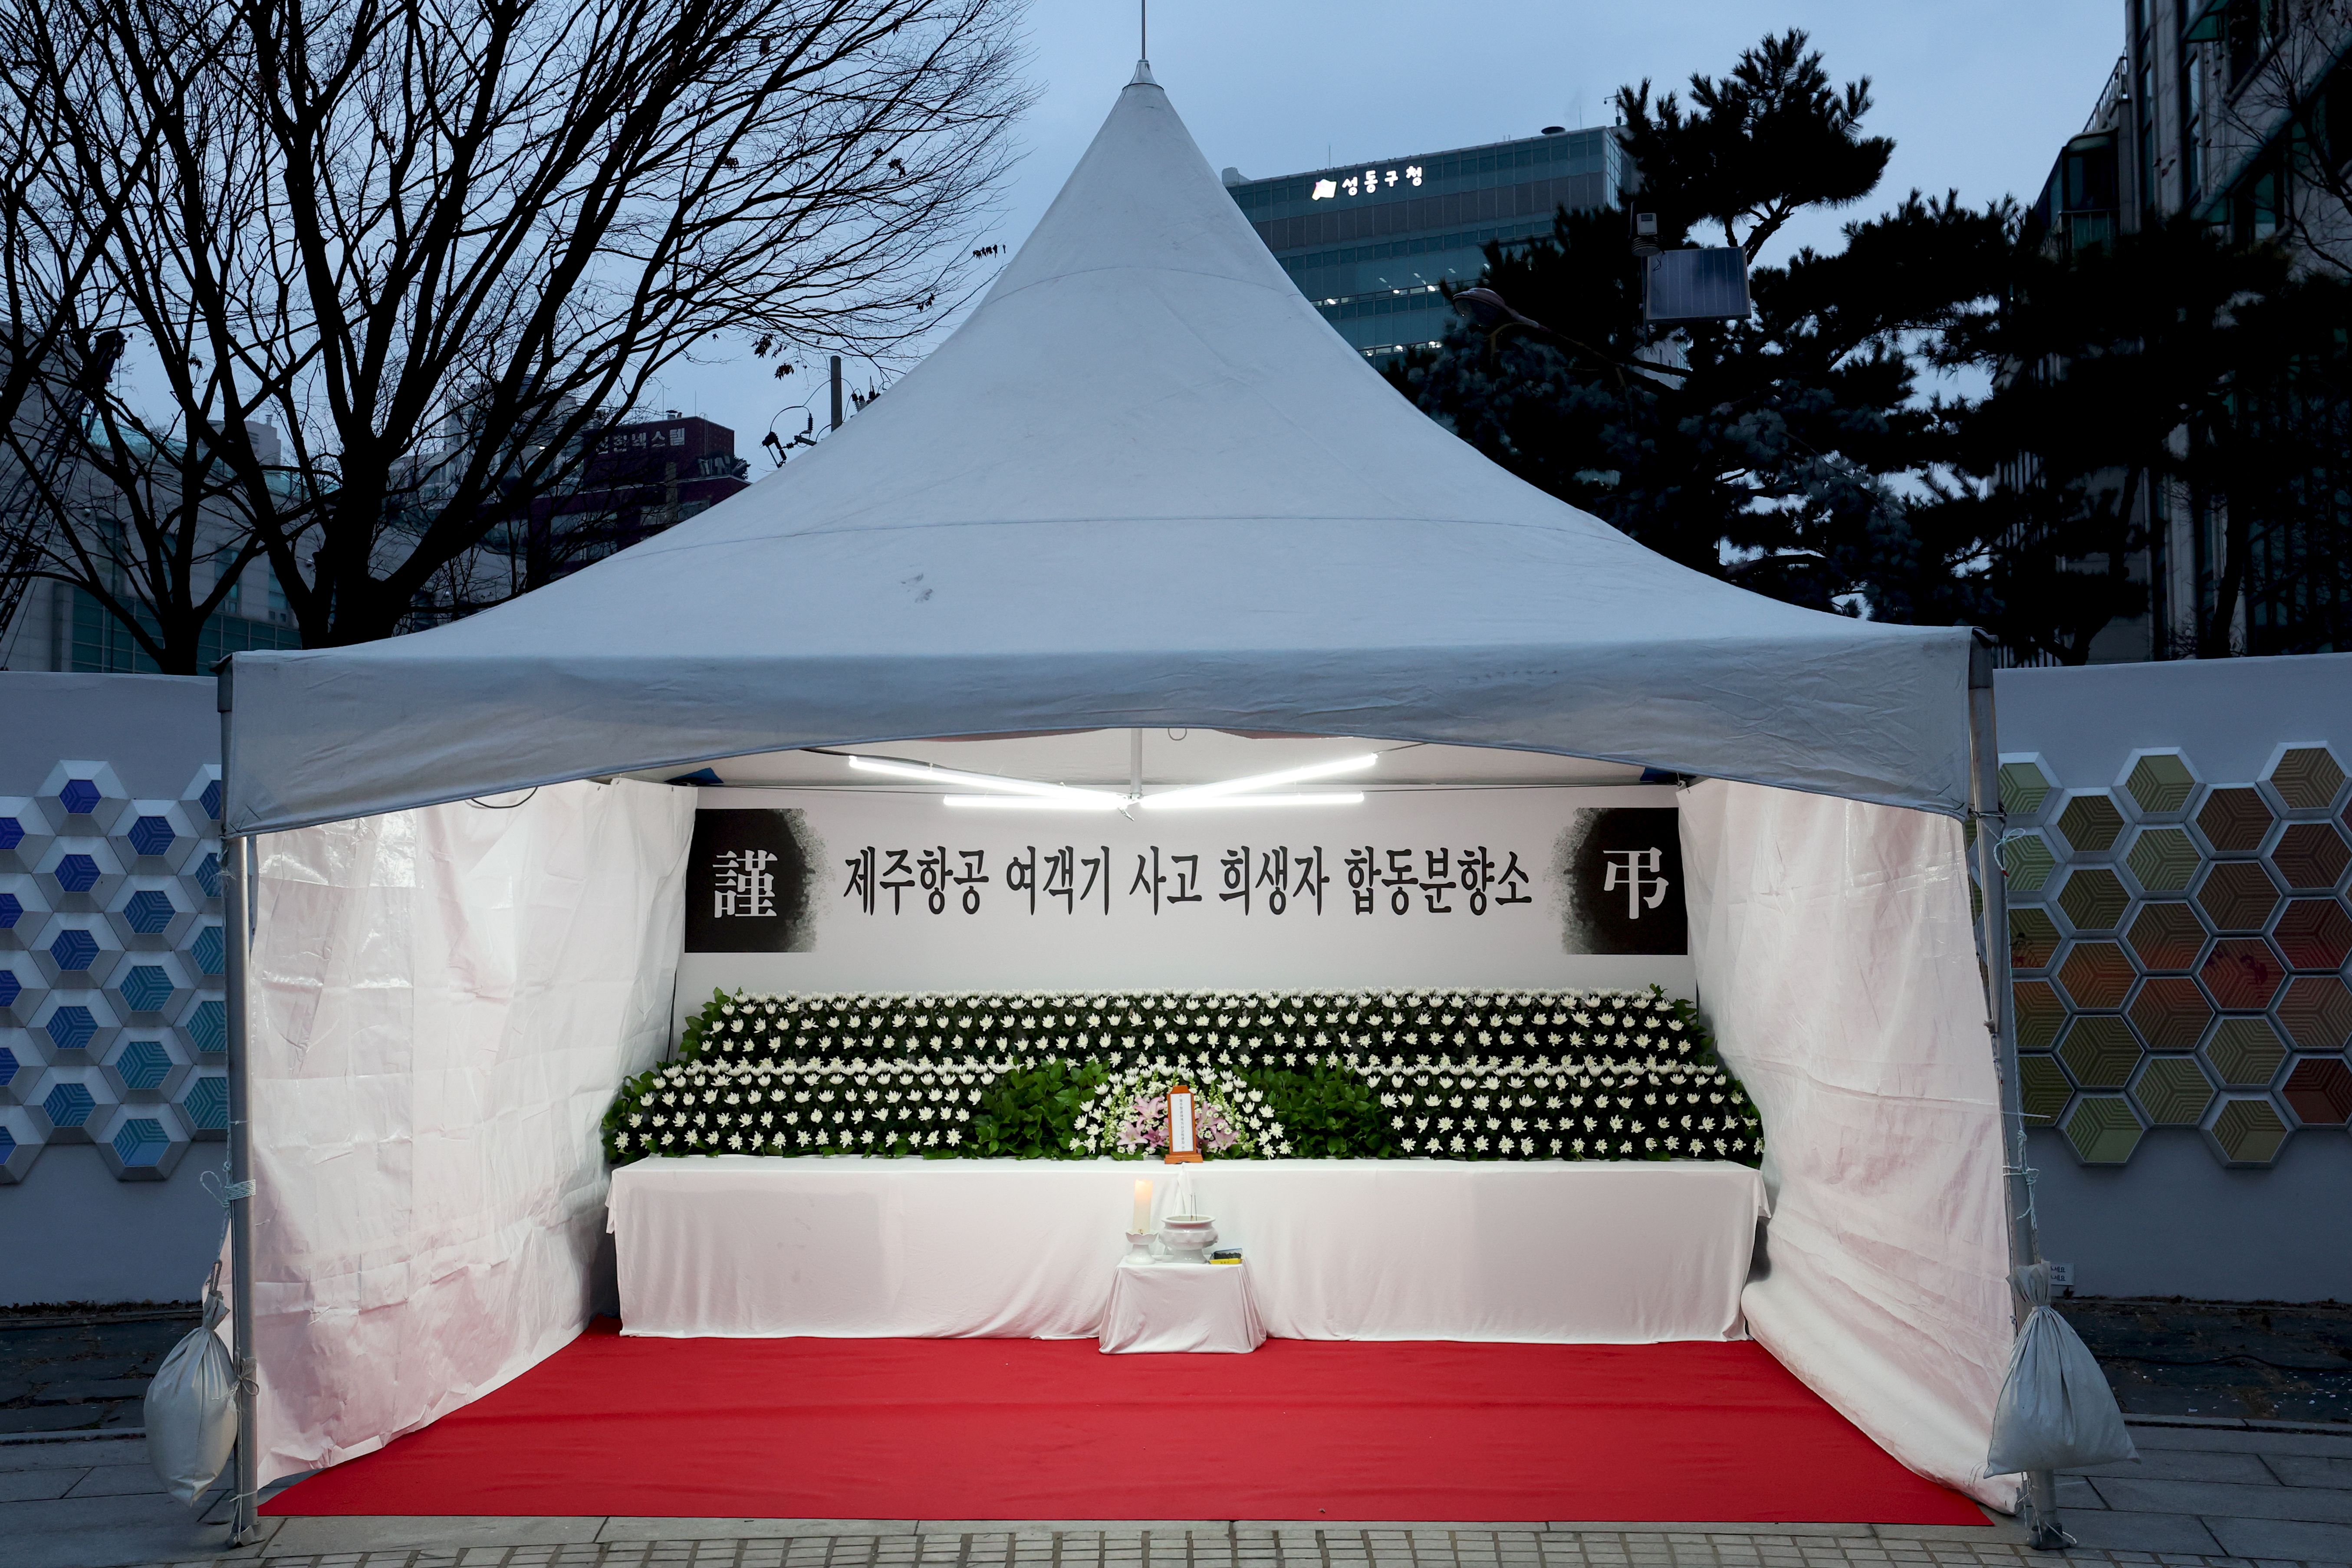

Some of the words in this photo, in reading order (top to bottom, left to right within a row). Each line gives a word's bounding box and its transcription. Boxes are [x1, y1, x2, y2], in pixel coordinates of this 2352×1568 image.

[1342, 166, 1422, 196] 성동구청
[712, 849, 778, 918] 謹
[843, 845, 989, 916] 제주항공
[1007, 845, 1109, 916] 여객기
[1129, 845, 1202, 916] 사고
[1219, 845, 1330, 916] 희생자
[1344, 845, 1532, 916] 합동분향소
[1602, 847, 1669, 919] 弔
